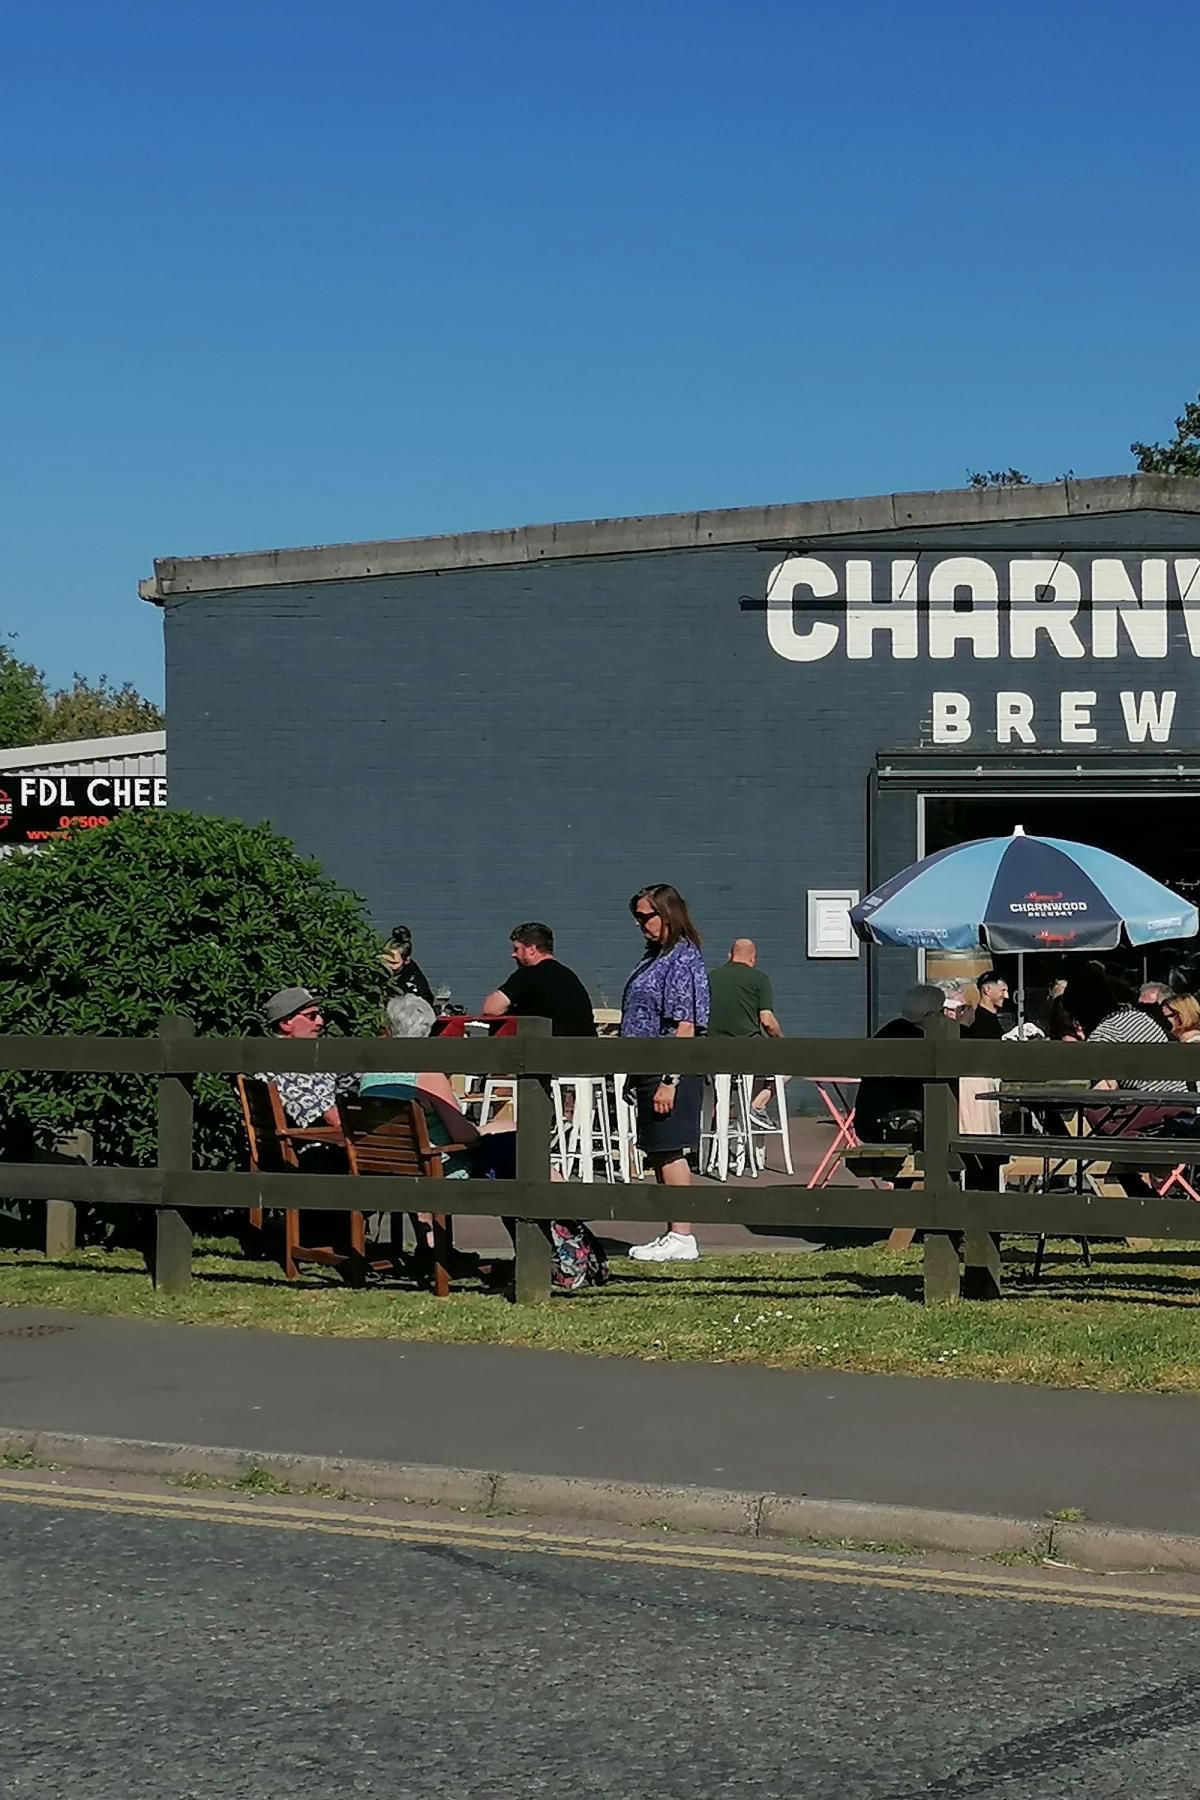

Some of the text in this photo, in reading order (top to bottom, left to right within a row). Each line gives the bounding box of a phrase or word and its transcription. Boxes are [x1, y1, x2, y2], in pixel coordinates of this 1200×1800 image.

[20, 778, 168, 807] FDL CHEE
[1009, 901, 1088, 912] CHARNWOOD
